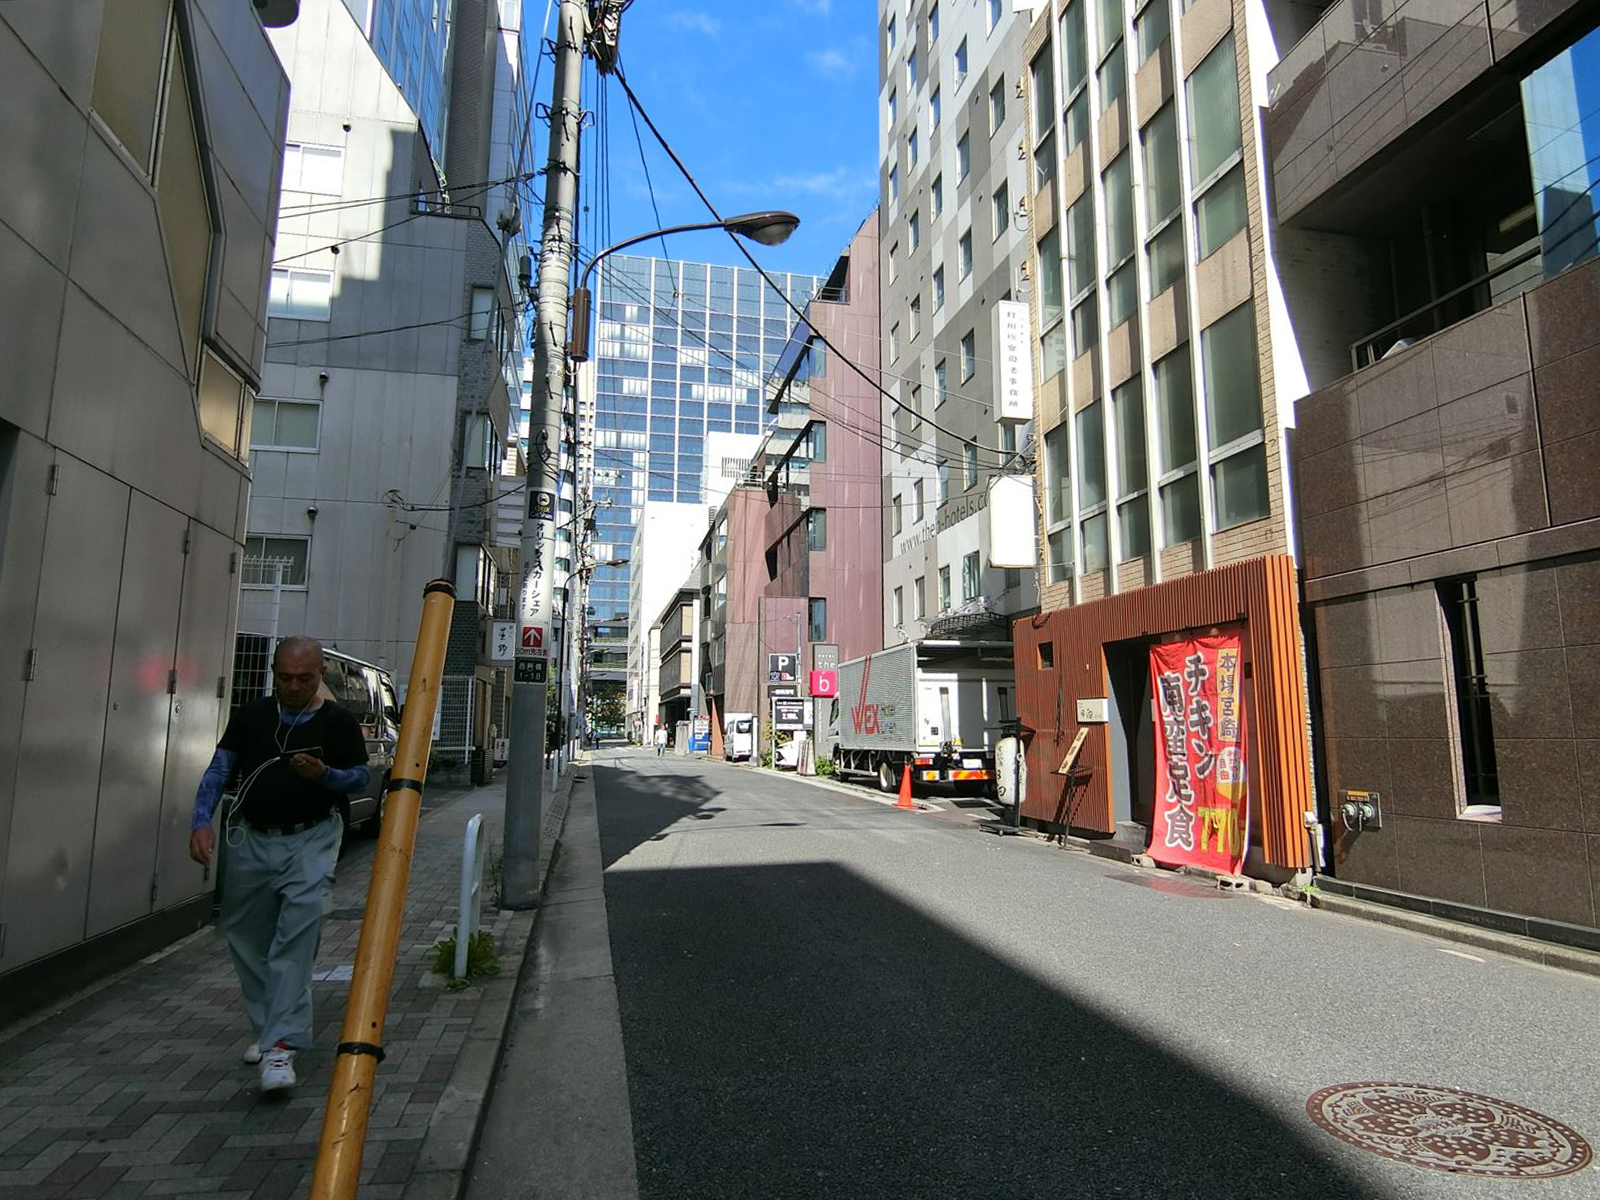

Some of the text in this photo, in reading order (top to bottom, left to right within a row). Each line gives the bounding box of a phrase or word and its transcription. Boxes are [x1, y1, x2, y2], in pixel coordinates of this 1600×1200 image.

[530, 522, 545, 616] オリックスカーシェア
[778, 656, 789, 671] P
[817, 661, 836, 669] the
[819, 676, 830, 692] b
[1219, 652, 1238, 739] 本場宮崎
[1185, 652, 1216, 780] チキン
[1159, 672, 1194, 851] 南蛮定食
[1198, 806, 1240, 856] 770
